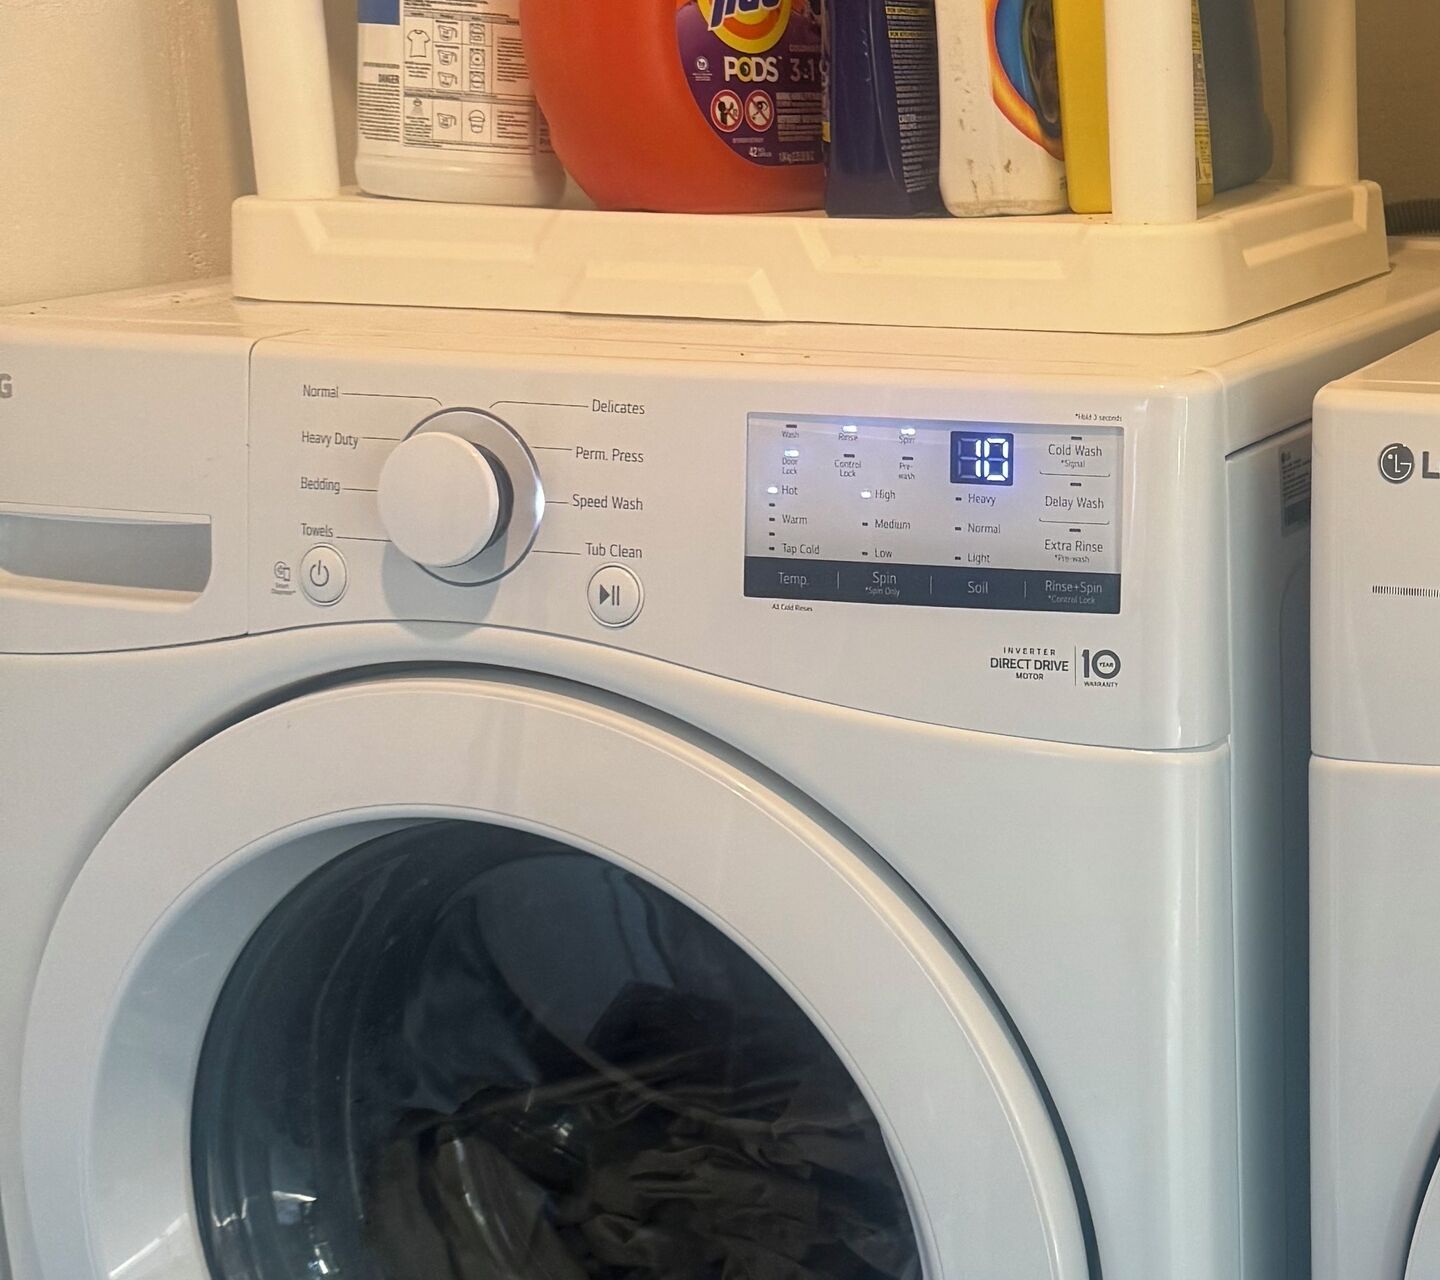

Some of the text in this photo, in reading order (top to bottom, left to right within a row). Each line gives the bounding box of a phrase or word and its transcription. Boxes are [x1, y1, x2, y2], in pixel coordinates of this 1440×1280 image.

[724, 56, 779, 83] PODS
[749, 147, 758, 157] 42
[303, 385, 339, 398] Normal
[592, 399, 645, 414] Delicates
[302, 431, 358, 449] Heavy Duty
[576, 446, 644, 463] Perm. Press
[1048, 444, 1102, 457] Cold Wash
[835, 460, 861, 469] Control
[976, 438, 1009, 481] 10
[840, 469, 856, 477] Lock
[301, 477, 340, 495] Bedding
[782, 486, 798, 495] Hot
[572, 494, 643, 510] Speed Wash
[875, 490, 895, 502] High
[968, 494, 996, 506] Heavy
[1045, 496, 1104, 510] Delay Wash
[782, 515, 808, 525] Warm
[875, 520, 911, 529] Medium
[301, 523, 333, 537] Towels
[967, 523, 1000, 534] Normal
[585, 543, 642, 558] Tub Clean
[782, 543, 820, 555] Tap Cold
[1045, 539, 1103, 552] Extra Rinse
[875, 549, 892, 558] Low
[967, 553, 990, 564] Light
[778, 572, 809, 587] Temp.
[873, 572, 896, 586] Spin
[967, 581, 989, 594] Soil
[1045, 580, 1102, 595] Rinse+Spin
[1004, 646, 1056, 655] INVERTER
[990, 658, 1068, 671] DIRECT DRIVE
[1082, 649, 1121, 679] 10
